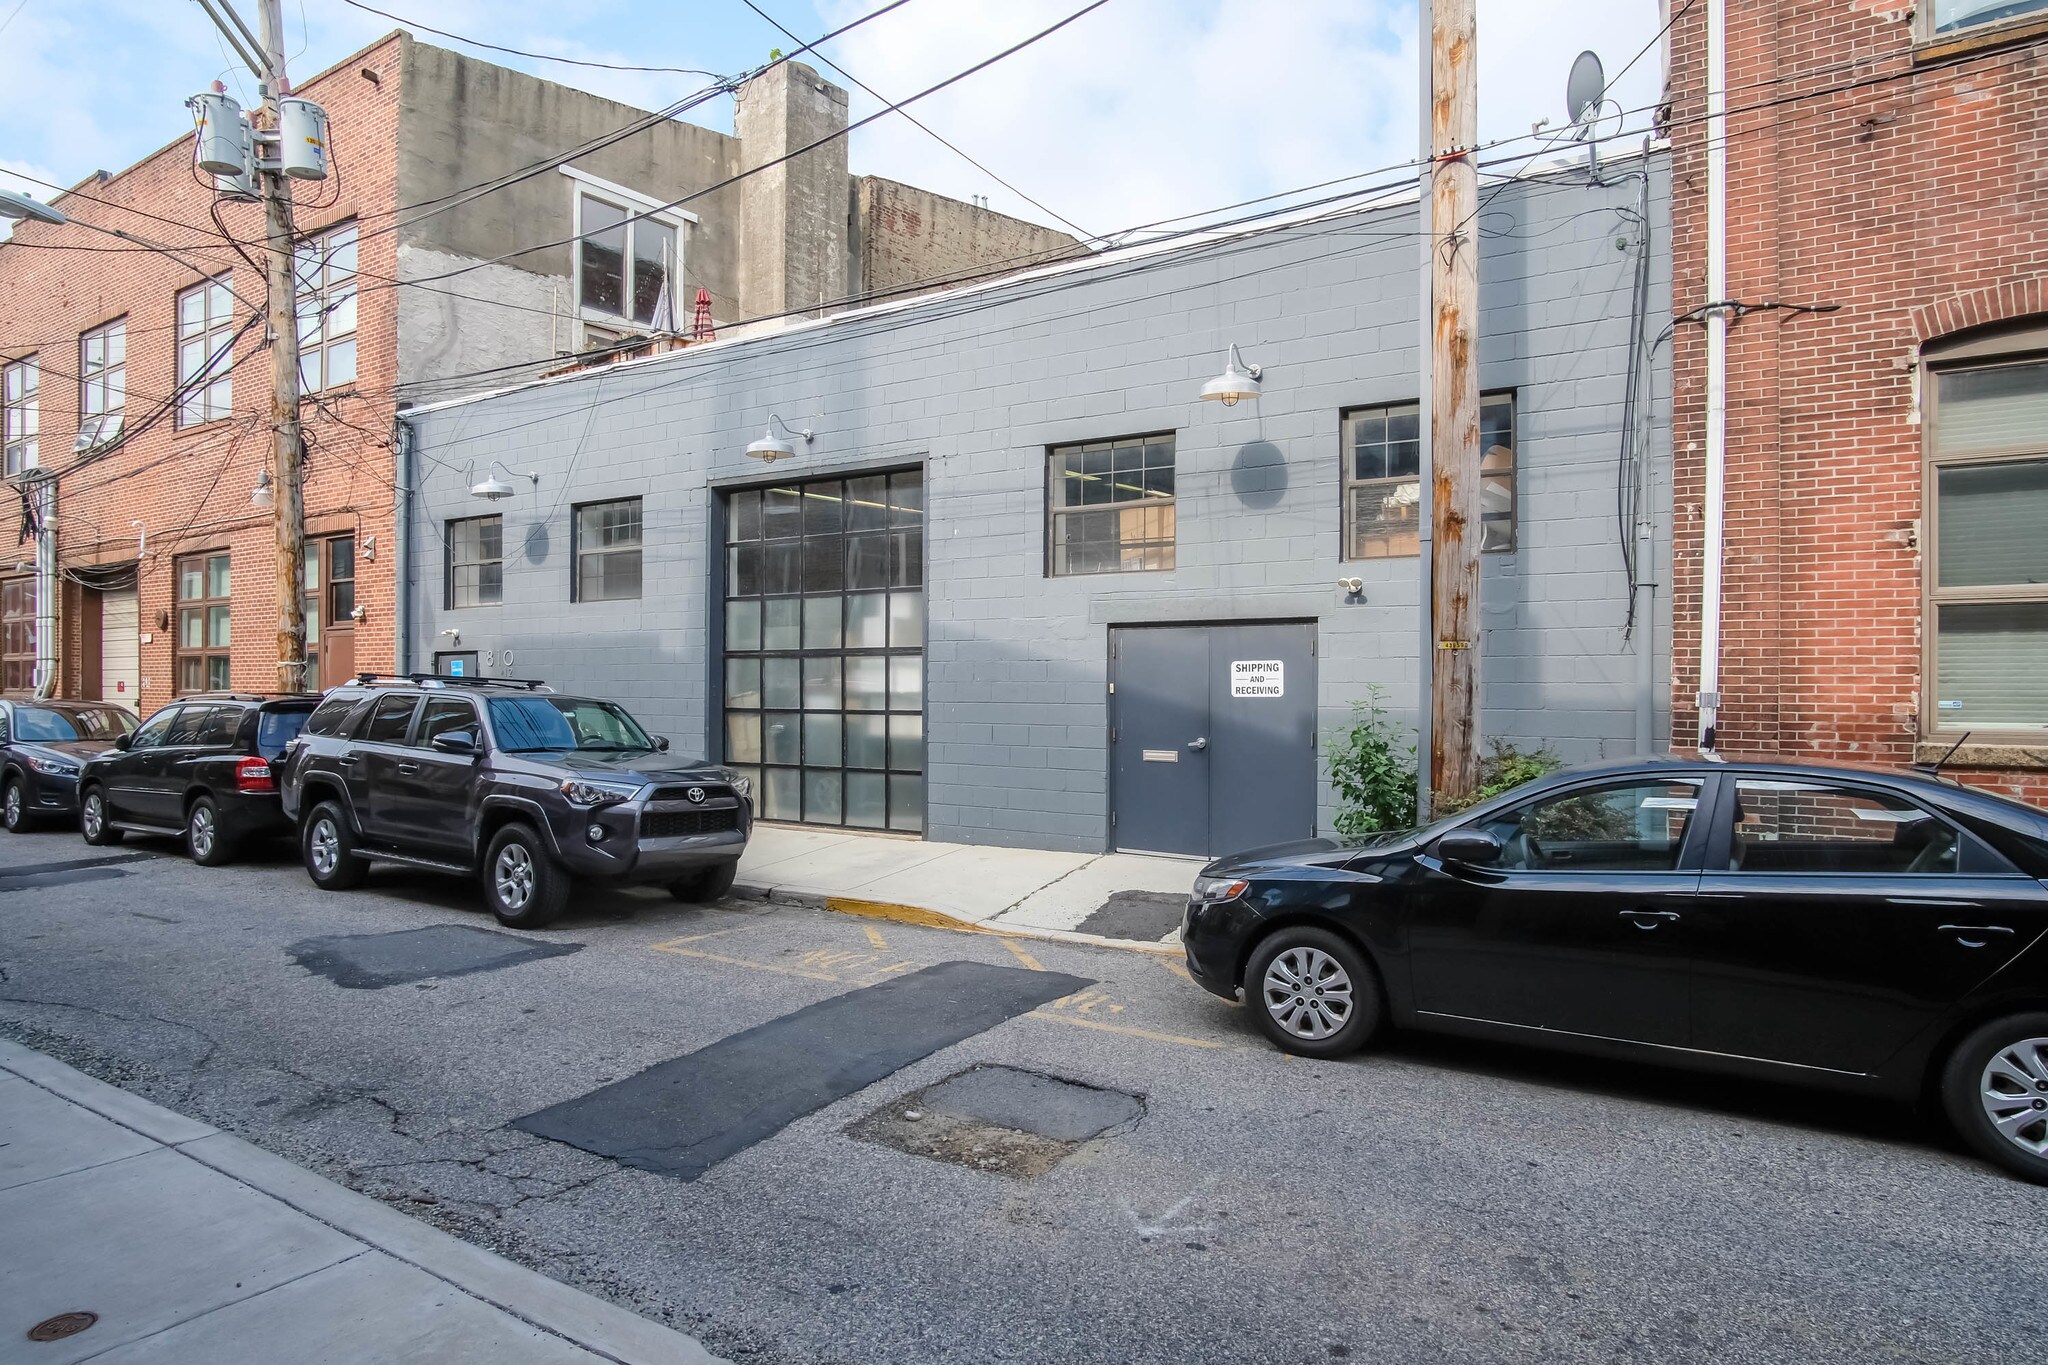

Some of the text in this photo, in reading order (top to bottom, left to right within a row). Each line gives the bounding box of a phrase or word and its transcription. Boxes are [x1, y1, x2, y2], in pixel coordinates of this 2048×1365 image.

[1235, 663, 1280, 673] SHIPPING
[1249, 675, 1265, 683] AND
[1235, 686, 1280, 695] RECEIVING
